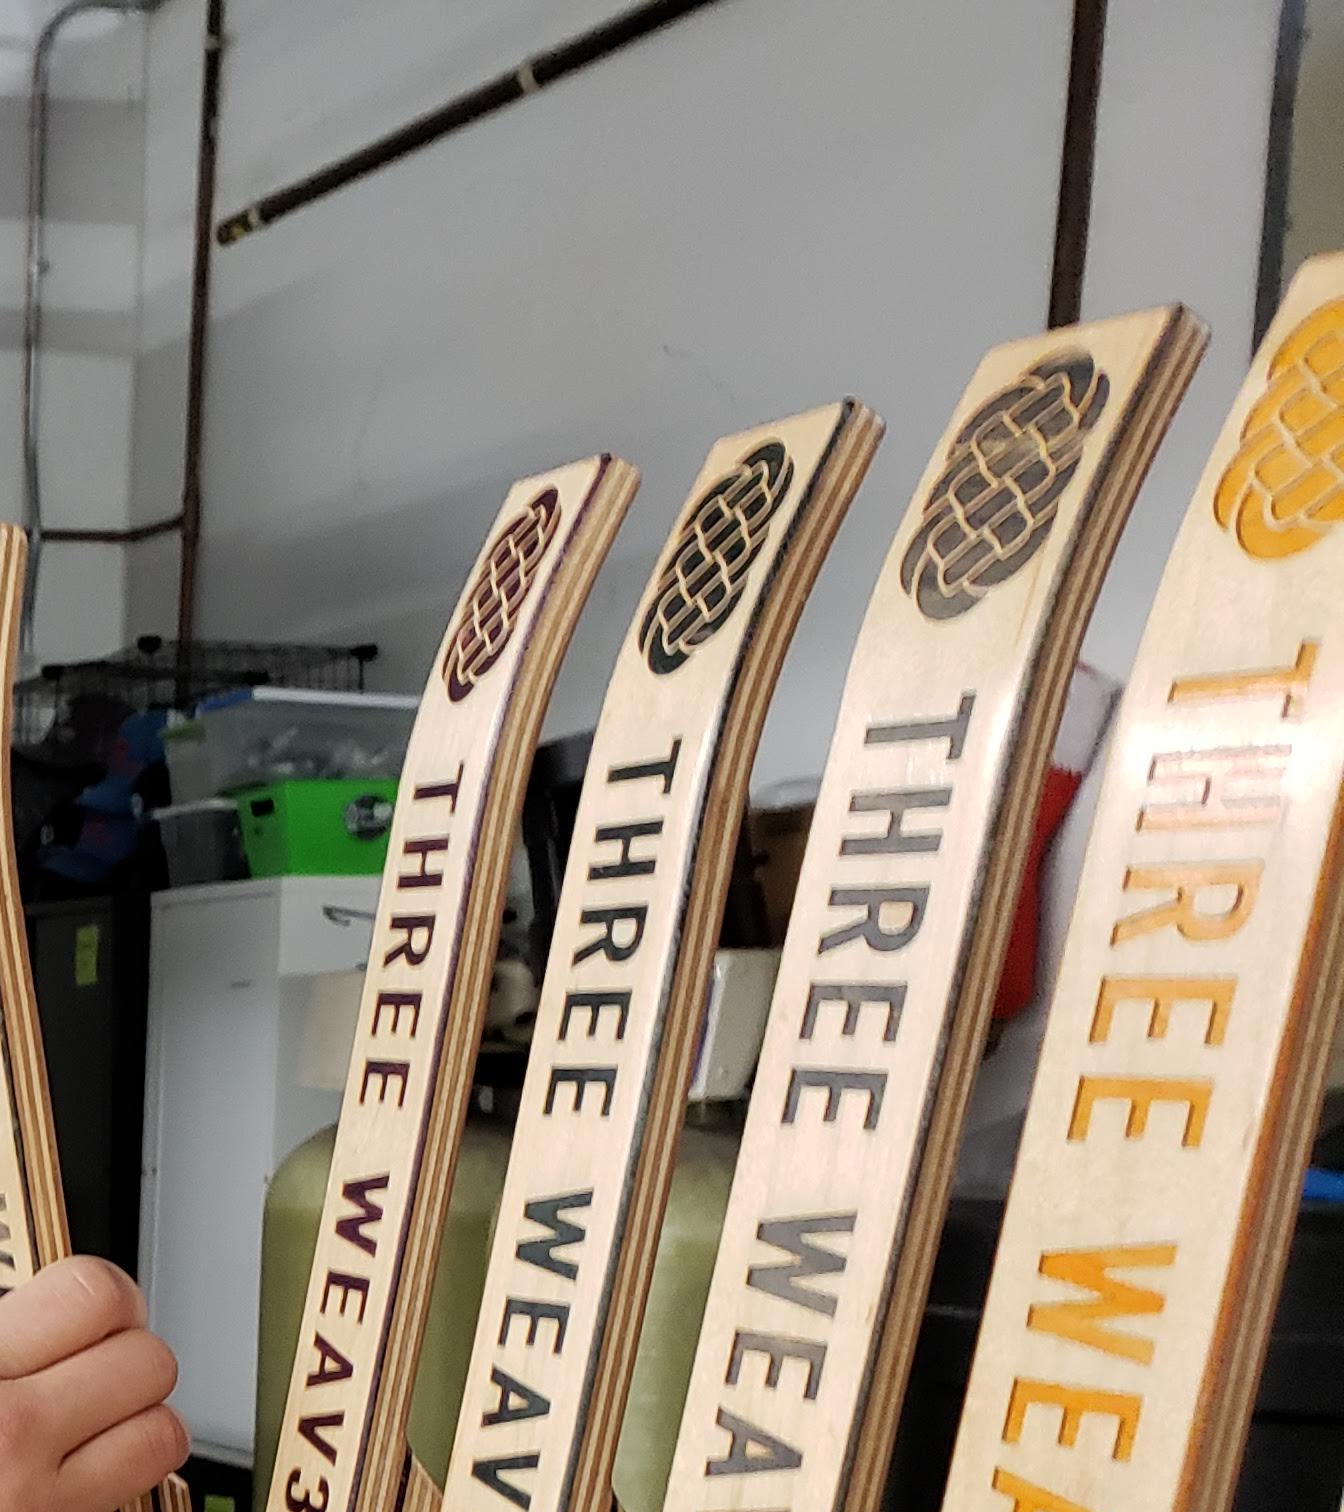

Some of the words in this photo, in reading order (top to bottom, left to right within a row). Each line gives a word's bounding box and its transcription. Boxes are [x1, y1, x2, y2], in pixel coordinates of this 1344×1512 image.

[359, 760, 465, 1109] THREE
[542, 736, 683, 1117] THREE
[780, 690, 977, 1132] THREE
[1066, 636, 1322, 1151] THREE
